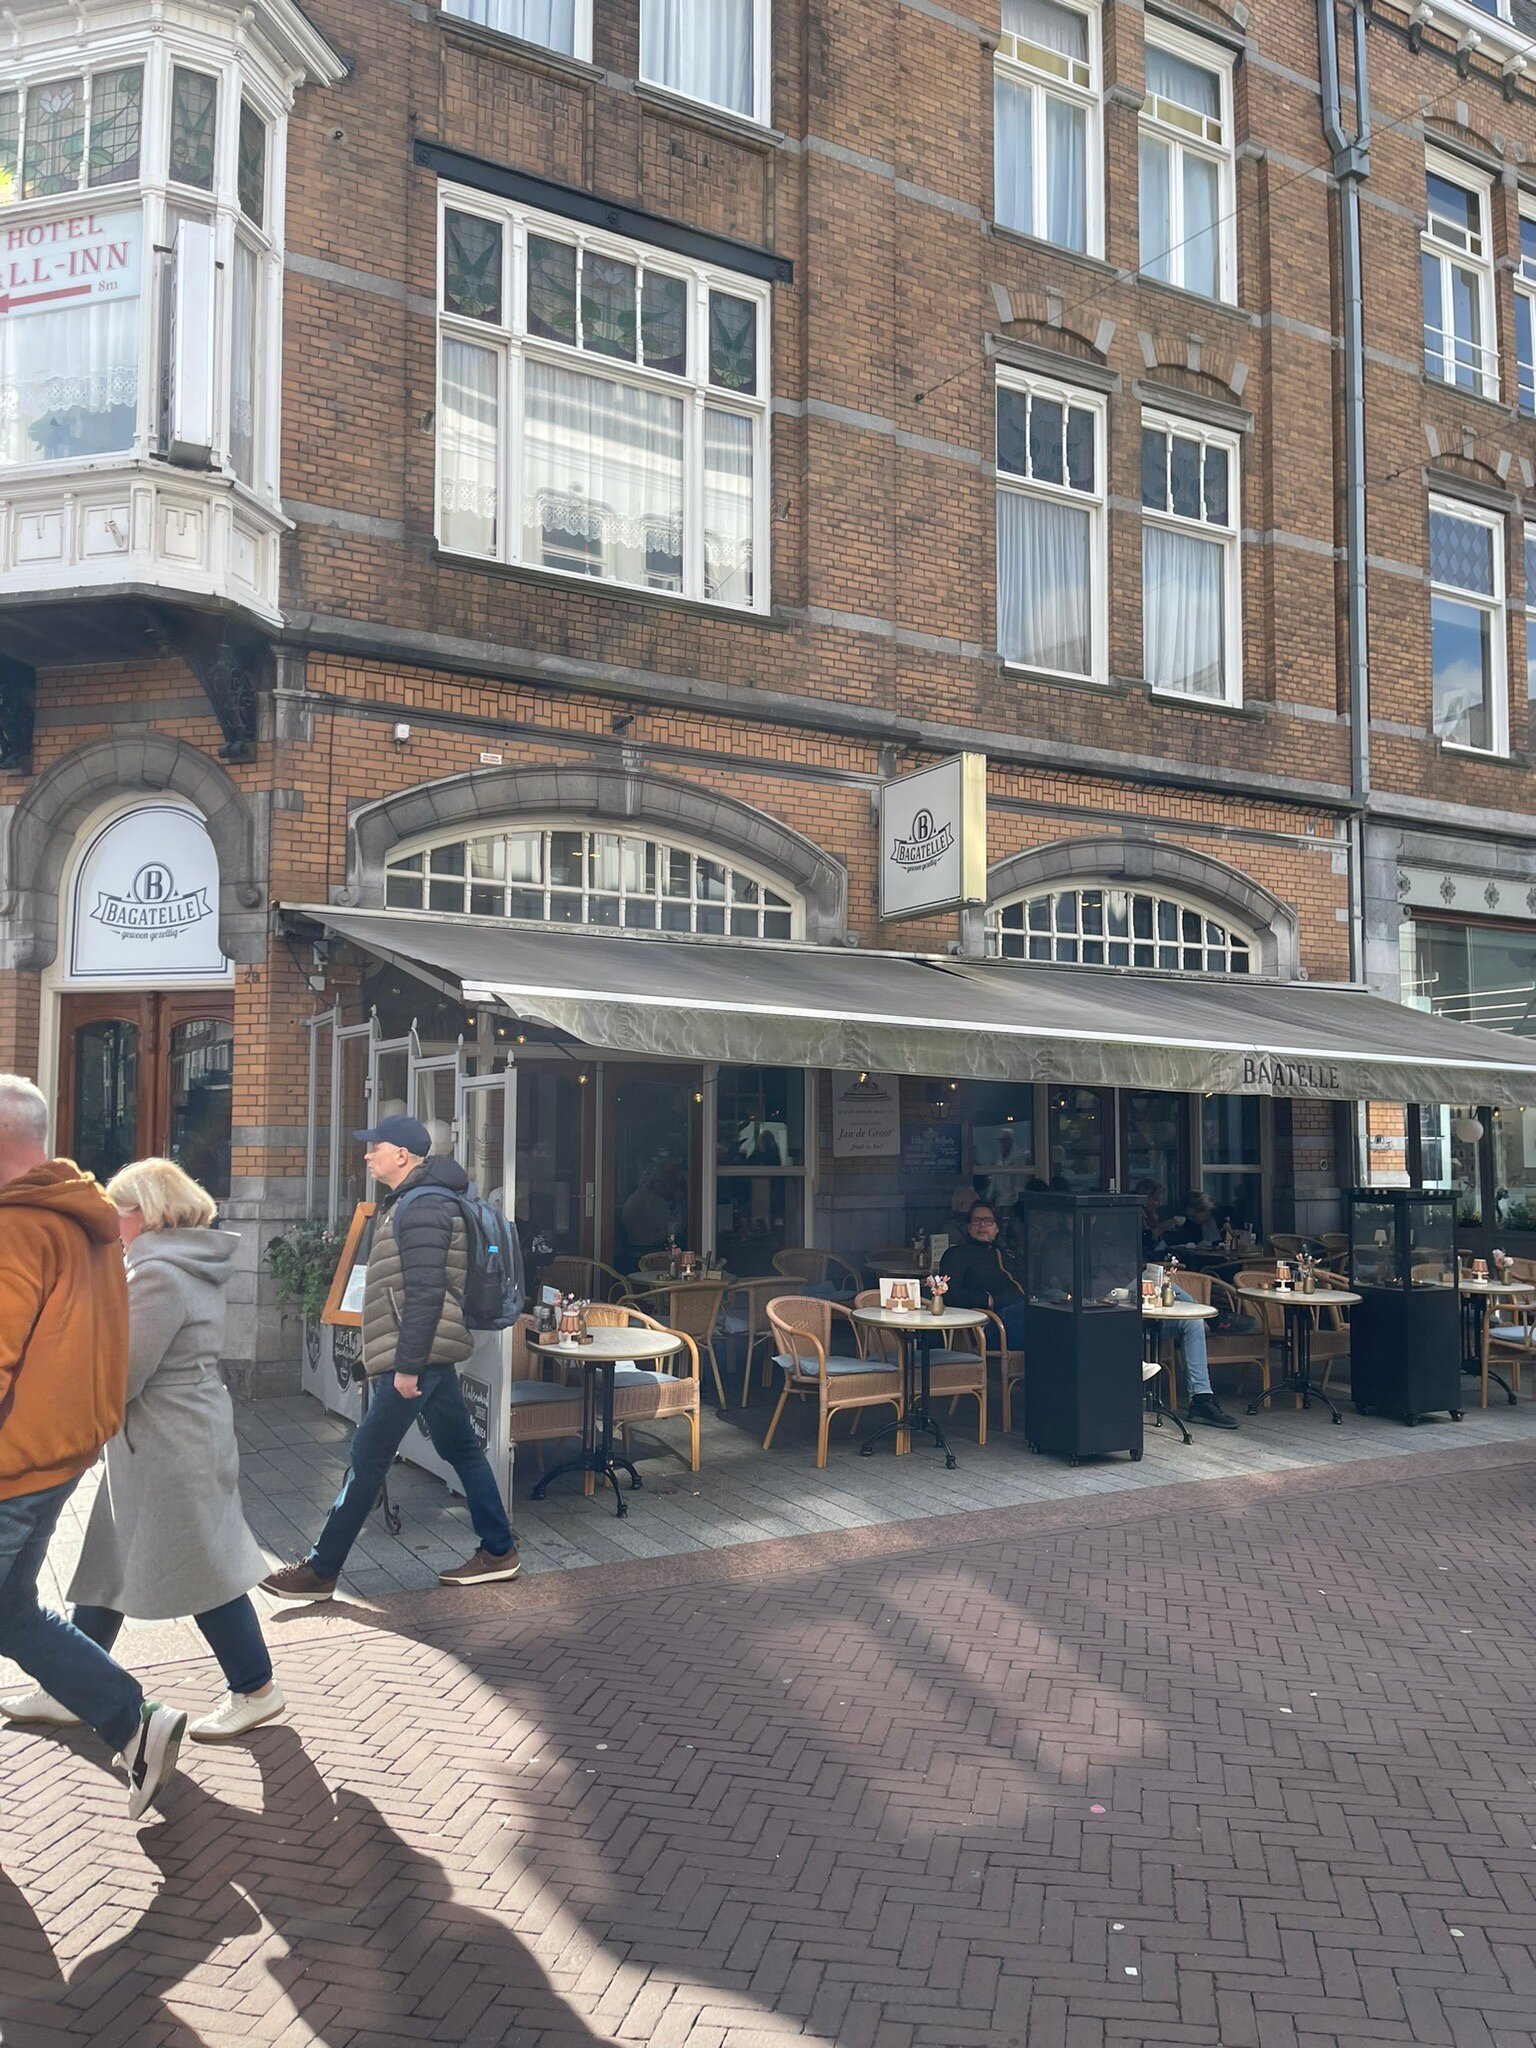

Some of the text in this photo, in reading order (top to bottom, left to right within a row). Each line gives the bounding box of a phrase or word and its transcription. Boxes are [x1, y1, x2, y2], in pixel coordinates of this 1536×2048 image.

[7, 215, 103, 251] HOTEL
[98, 280, 118, 291] 8m
[918, 815, 928, 839] B
[899, 836, 945, 860] BAGATELLE
[144, 870, 163, 900] B
[106, 901, 196, 926] BAGATELLE
[121, 928, 178, 941] gewoon gezellig
[838, 1127, 892, 1141] Jan de Groot
